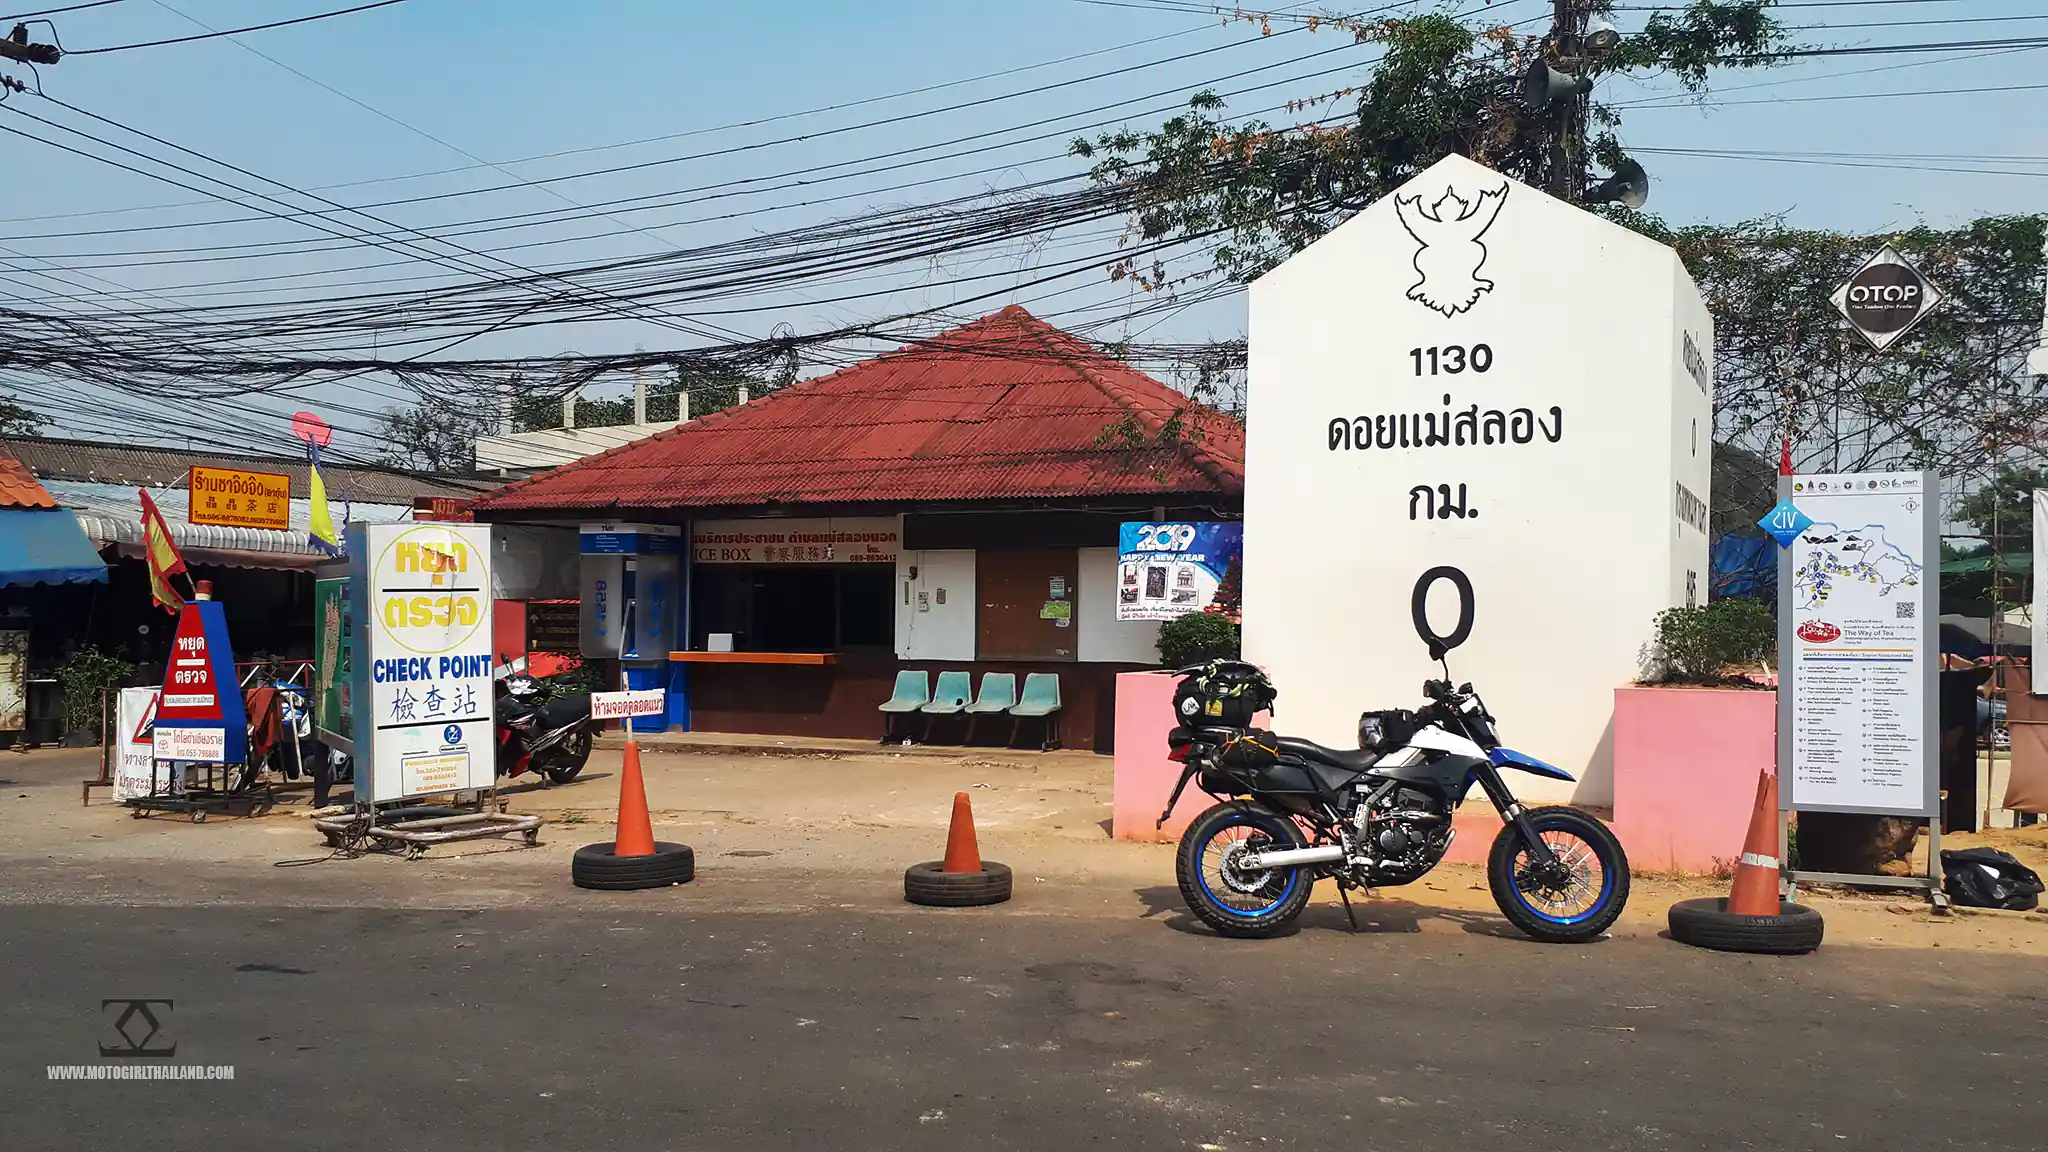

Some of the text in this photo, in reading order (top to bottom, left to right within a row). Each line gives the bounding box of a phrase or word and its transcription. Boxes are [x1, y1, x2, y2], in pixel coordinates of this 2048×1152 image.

[1849, 285, 1918, 302] OTOP
[1409, 343, 1493, 376] 1130
[1328, 393, 1563, 450] ดอยแม่สลอง
[1409, 482, 1479, 520] กม.
[395, 541, 468, 585] หยุด
[721, 548, 752, 561] BOX
[1120, 553, 1205, 562] HAPPY NEW YEAR
[384, 596, 478, 628] ตรวจ
[1411, 565, 1475, 651] 0
[178, 636, 205, 657] หยุด
[1858, 630, 1872, 638] Way
[175, 669, 208, 684] ตรวจ
[373, 655, 492, 683] CHECK POINT
[389, 684, 477, 723] 檢查站
